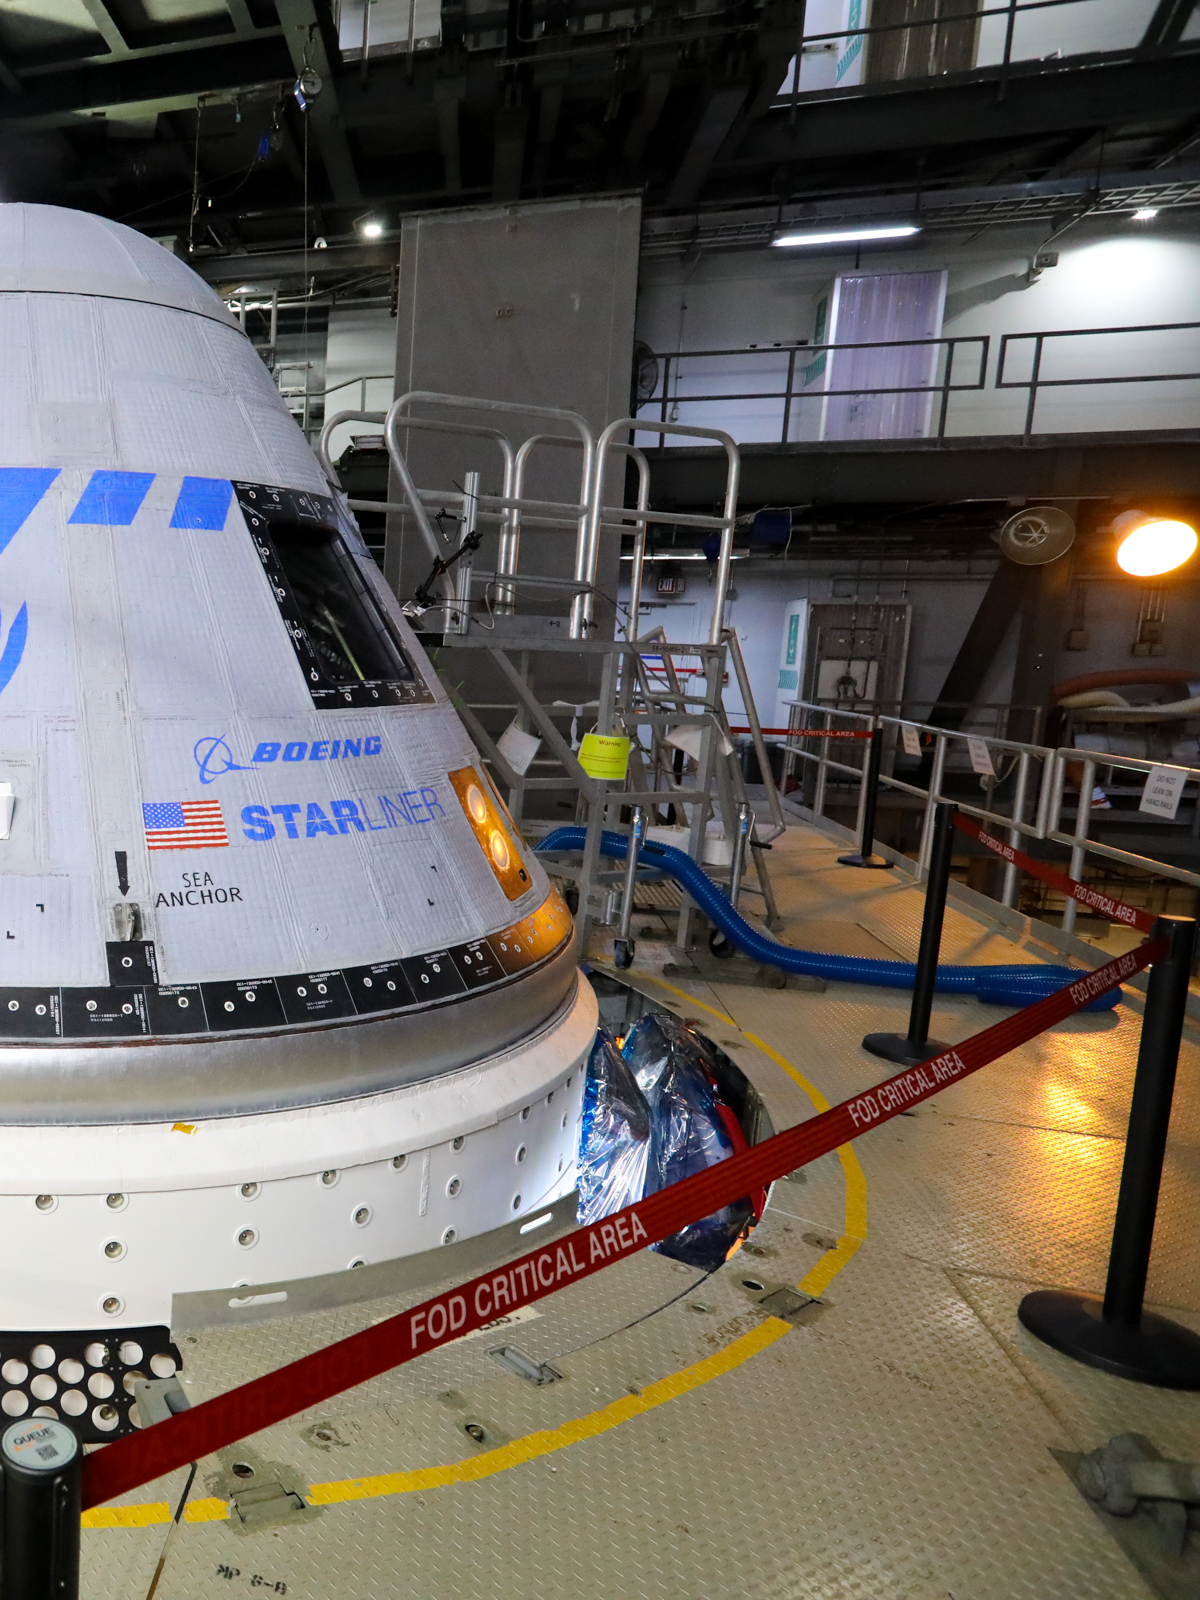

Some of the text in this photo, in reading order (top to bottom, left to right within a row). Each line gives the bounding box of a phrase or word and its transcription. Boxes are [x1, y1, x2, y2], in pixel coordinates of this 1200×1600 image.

[658, 578, 673, 591] EXIT
[251, 735, 383, 763] BOEING
[599, 740, 621, 748] Warning
[1165, 777, 1177, 785] NOT
[240, 788, 447, 842] STARLINER
[979, 831, 1015, 861] FOD CRITICAL AREA
[182, 871, 214, 888] SEA
[155, 887, 244, 908] ANCHOR
[1073, 884, 1137, 924] FOD CRITICAL AREA
[1070, 954, 1137, 1005] FOD CRITICAL AREA
[847, 1051, 966, 1128] FOD CRITICAL AREA
[410, 1212, 648, 1349] FOD CRITICAL AREA
[14, 1427, 51, 1446] QUEUE
